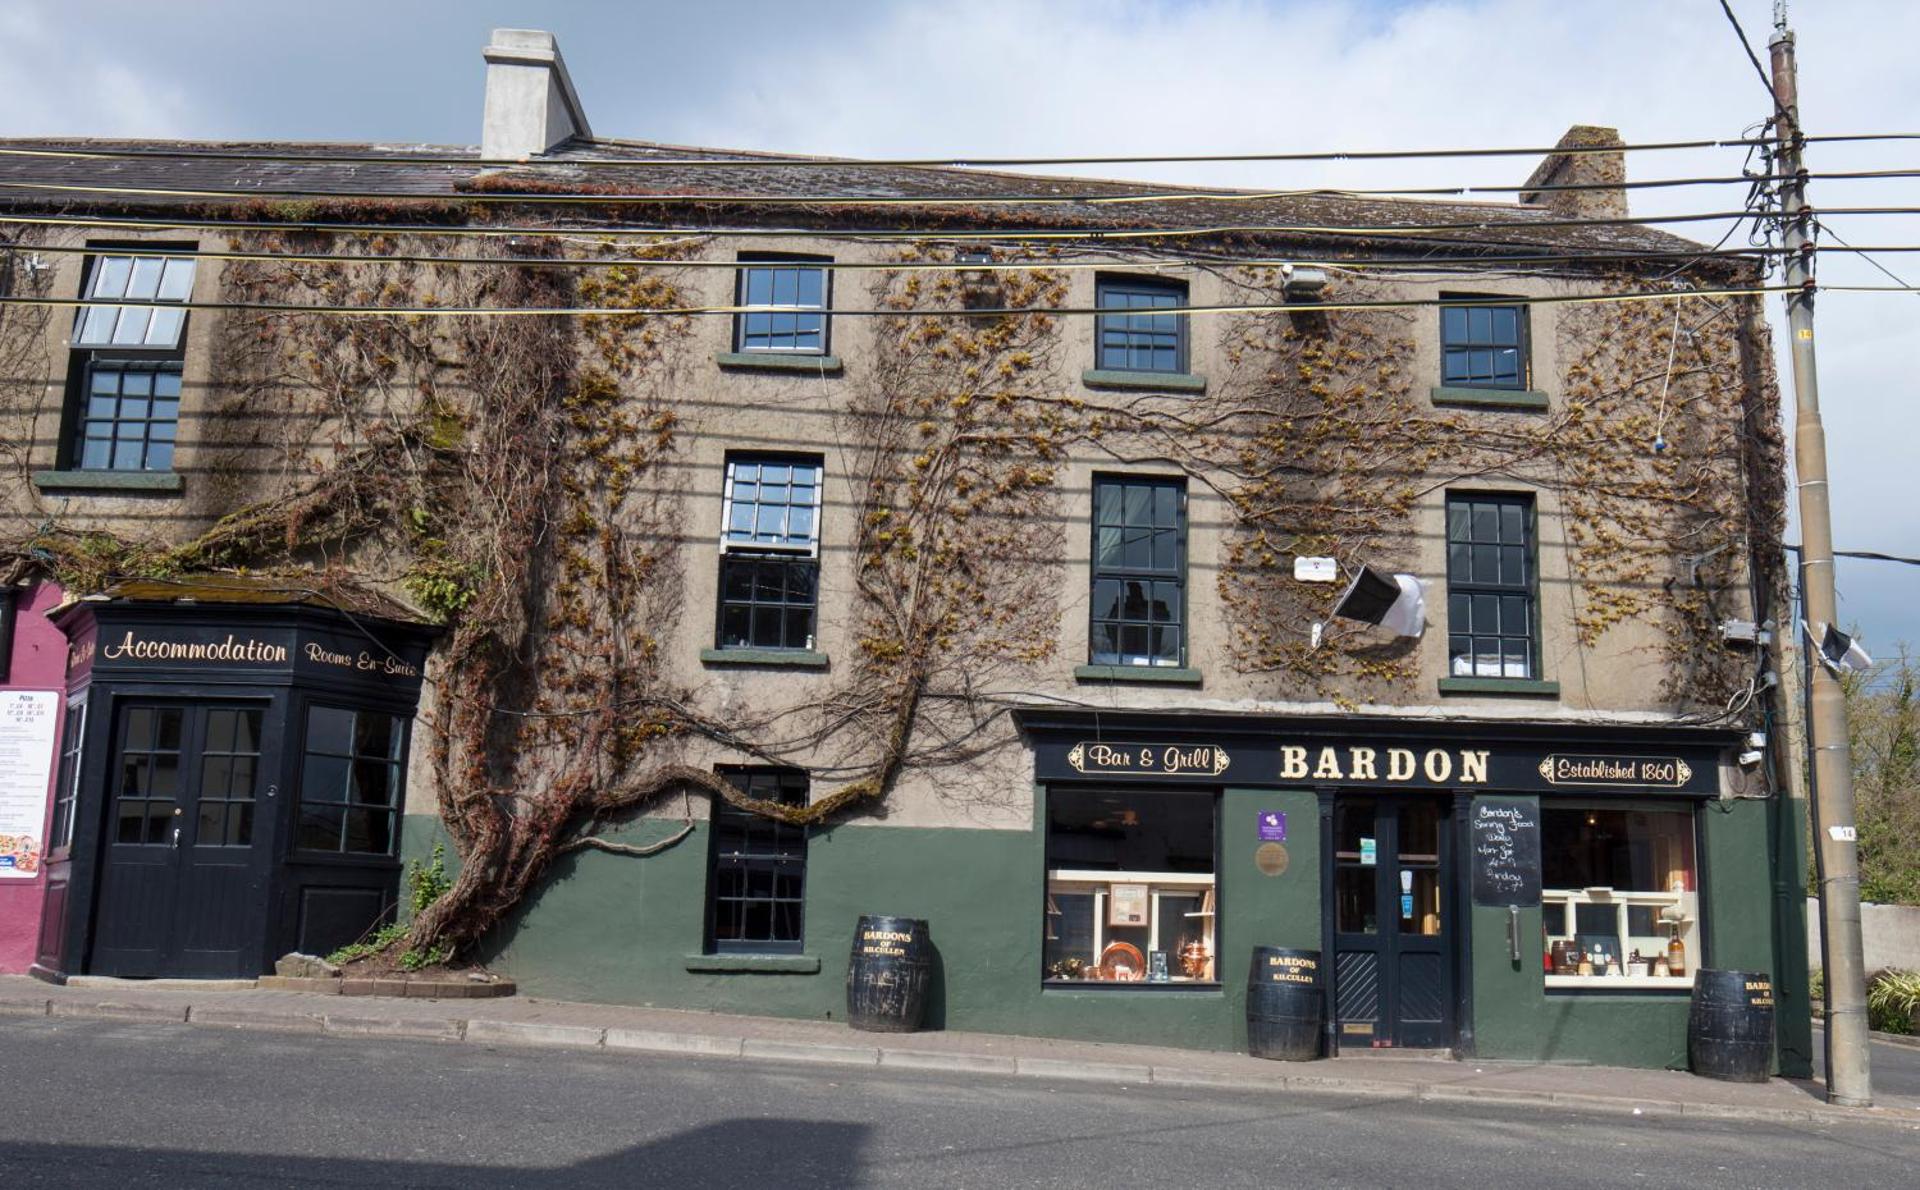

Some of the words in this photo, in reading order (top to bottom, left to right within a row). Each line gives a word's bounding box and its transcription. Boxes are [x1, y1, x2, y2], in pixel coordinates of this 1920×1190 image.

[104, 631, 286, 662] Accommodation
[304, 642, 352, 667] Rooms
[1088, 745, 1131, 766] Bar
[1140, 748, 1154, 767] &
[1164, 747, 1210, 773] Grill
[1280, 745, 1490, 783] BARDON
[1557, 758, 1635, 779] Established
[1642, 763, 1674, 781] 1860
[864, 931, 911, 942] BARDONS
[1269, 957, 1316, 969] BARDONS
